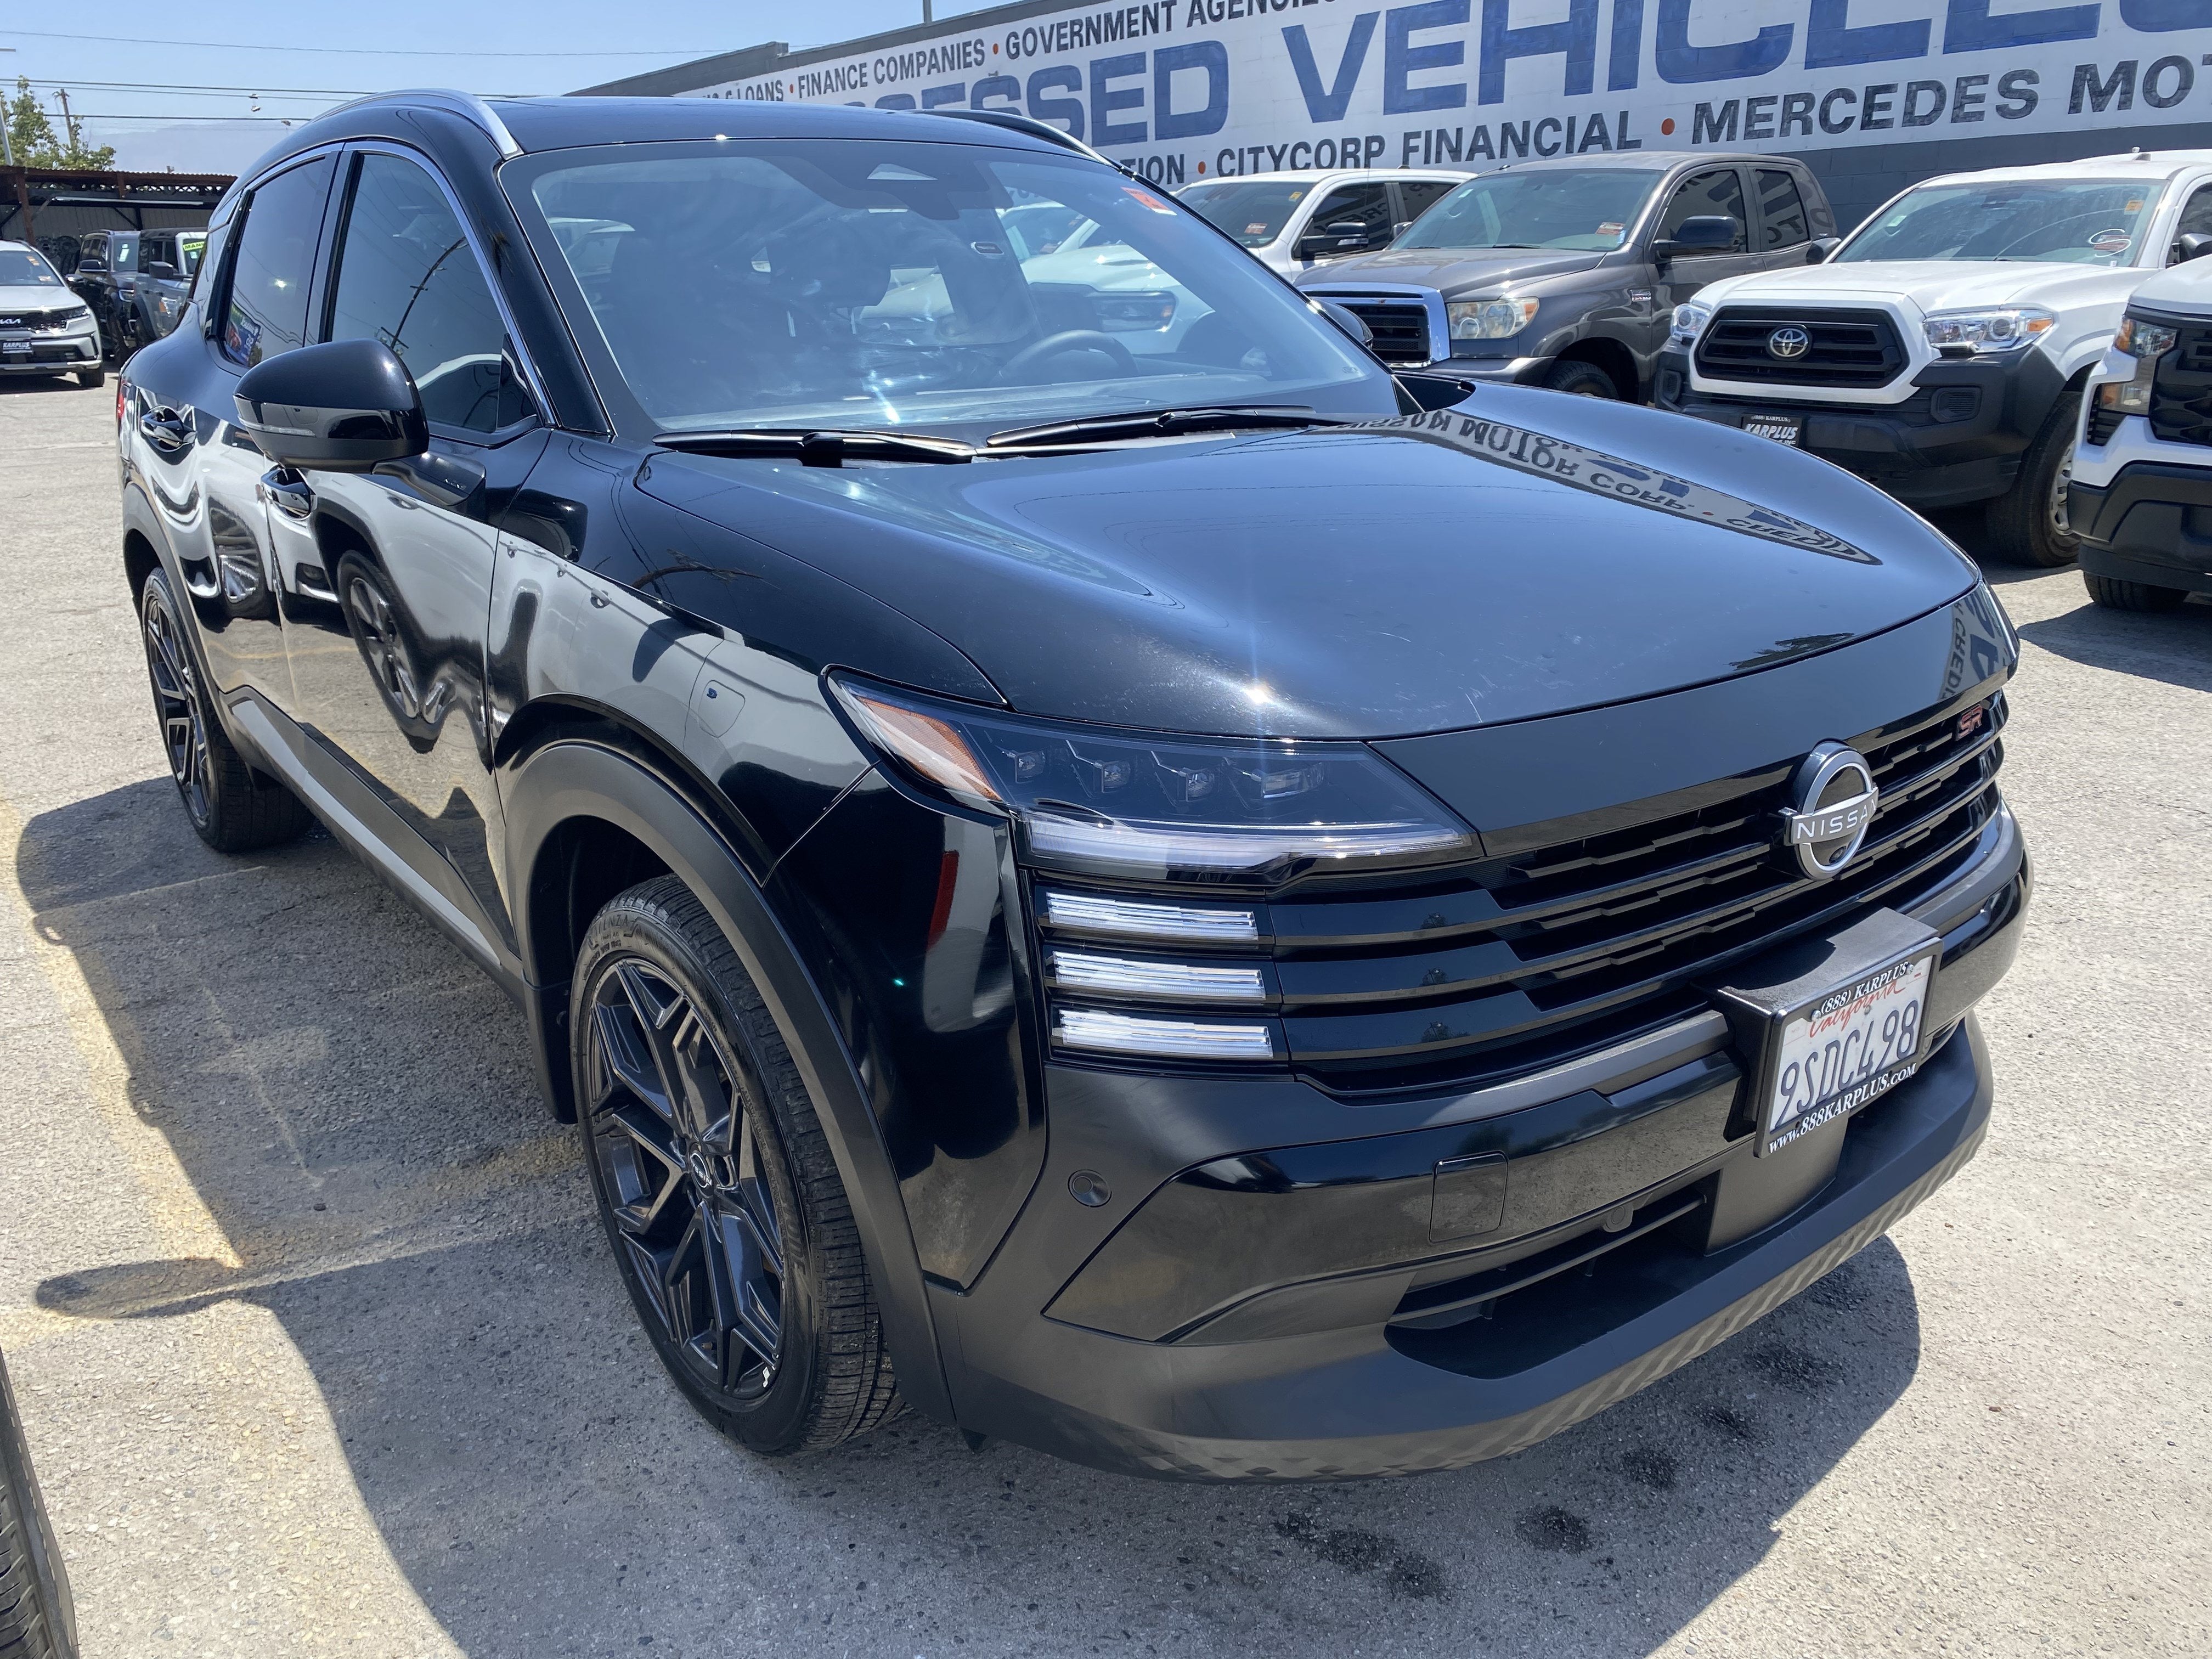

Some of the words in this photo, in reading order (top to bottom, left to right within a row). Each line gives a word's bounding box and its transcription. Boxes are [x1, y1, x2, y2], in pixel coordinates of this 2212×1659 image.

[798, 62, 867, 99] FINANCE
[874, 38, 986, 84] COMPANIES
[1006, 0, 1173, 59] GOVERNMENT
[1216, 135, 1386, 177] CITYCORP
[1401, 111, 1643, 165] FINANCIAL
[1691, 69, 2040, 144] MERCEDES
[1745, 424, 1798, 439] KARPLUS
[1957, 704, 1983, 739] SR
[1797, 798, 1877, 839] NISSAN
[1820, 989, 1852, 1015] (888)
[1853, 961, 1909, 1001] KARPLUS
[1774, 1000, 1920, 1130] 9SDC498
